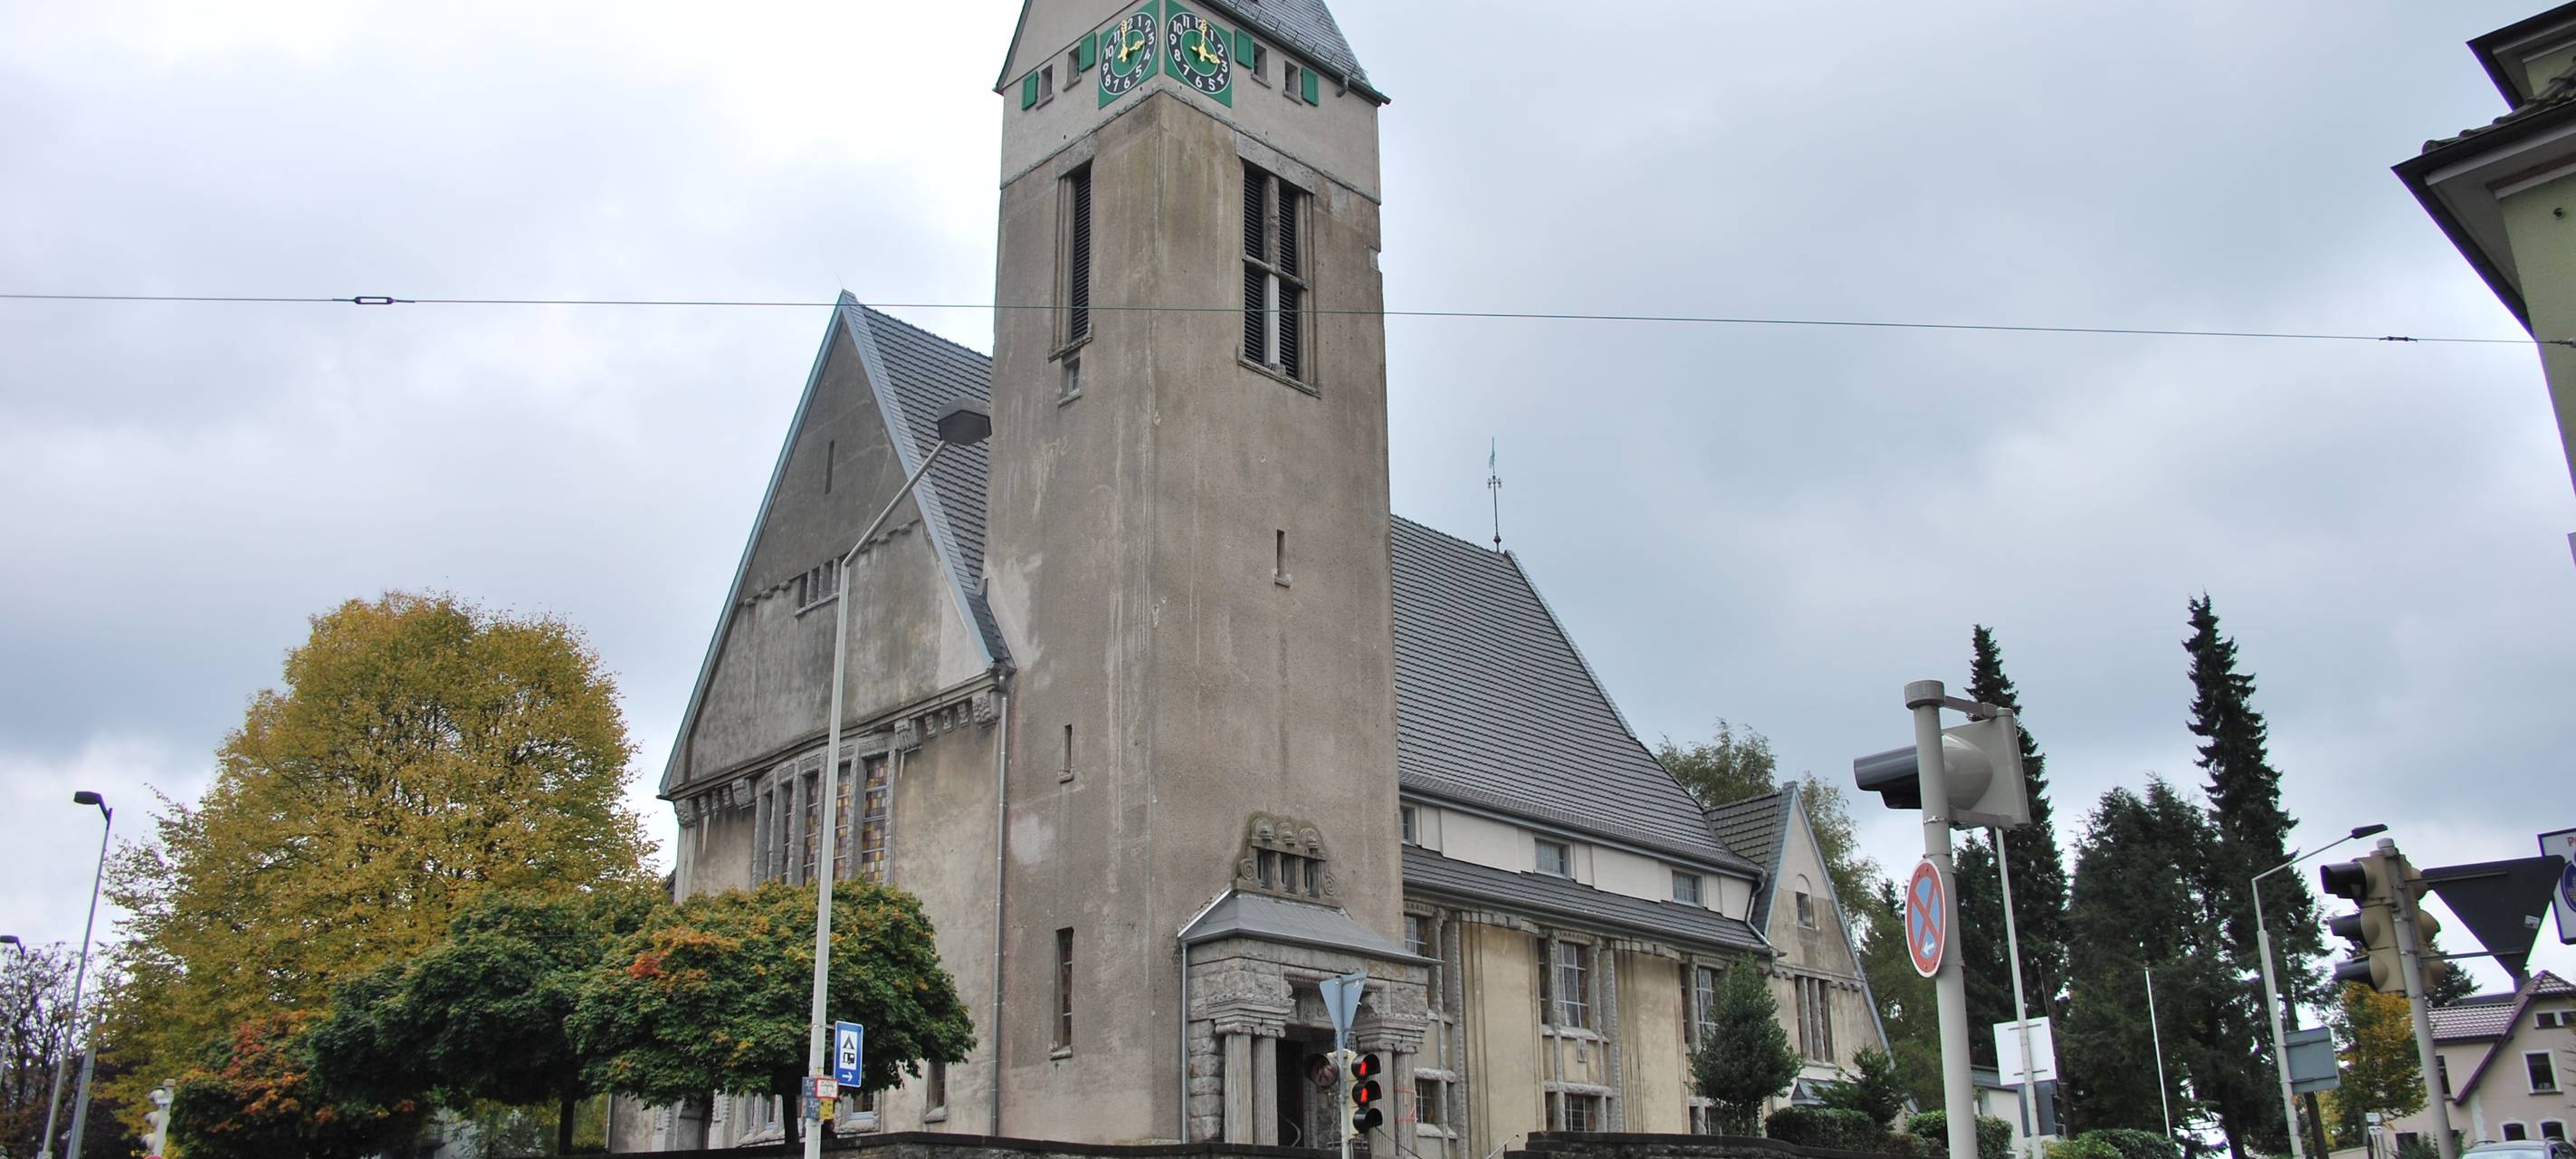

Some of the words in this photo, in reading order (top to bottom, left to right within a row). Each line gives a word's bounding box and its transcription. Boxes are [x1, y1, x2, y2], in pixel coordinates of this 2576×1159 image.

[1138, 16, 1141, 27] 1
[1145, 19, 1151, 32] 2
[1173, 20, 1183, 35] 10
[1183, 15, 1189, 28] 11
[1114, 30, 1120, 43] 11
[1148, 32, 1154, 44] 3
[1170, 34, 1176, 45] 9
[1210, 29, 1214, 42] 1
[1105, 45, 1113, 59] 10
[1143, 49, 1150, 60] 4
[1174, 49, 1181, 61] 8
[1217, 44, 1224, 57] 2
[1103, 63, 1109, 75] 9
[1136, 65, 1142, 77] 5
[1183, 64, 1190, 75] 7
[1221, 60, 1228, 73] 3
[1105, 75, 1111, 86] 8
[1114, 78, 1119, 91] 7
[1124, 77, 1130, 89] 6
[1195, 76, 1202, 88] 6
[1209, 78, 1215, 91] 5
[1217, 74, 1224, 85] 4
